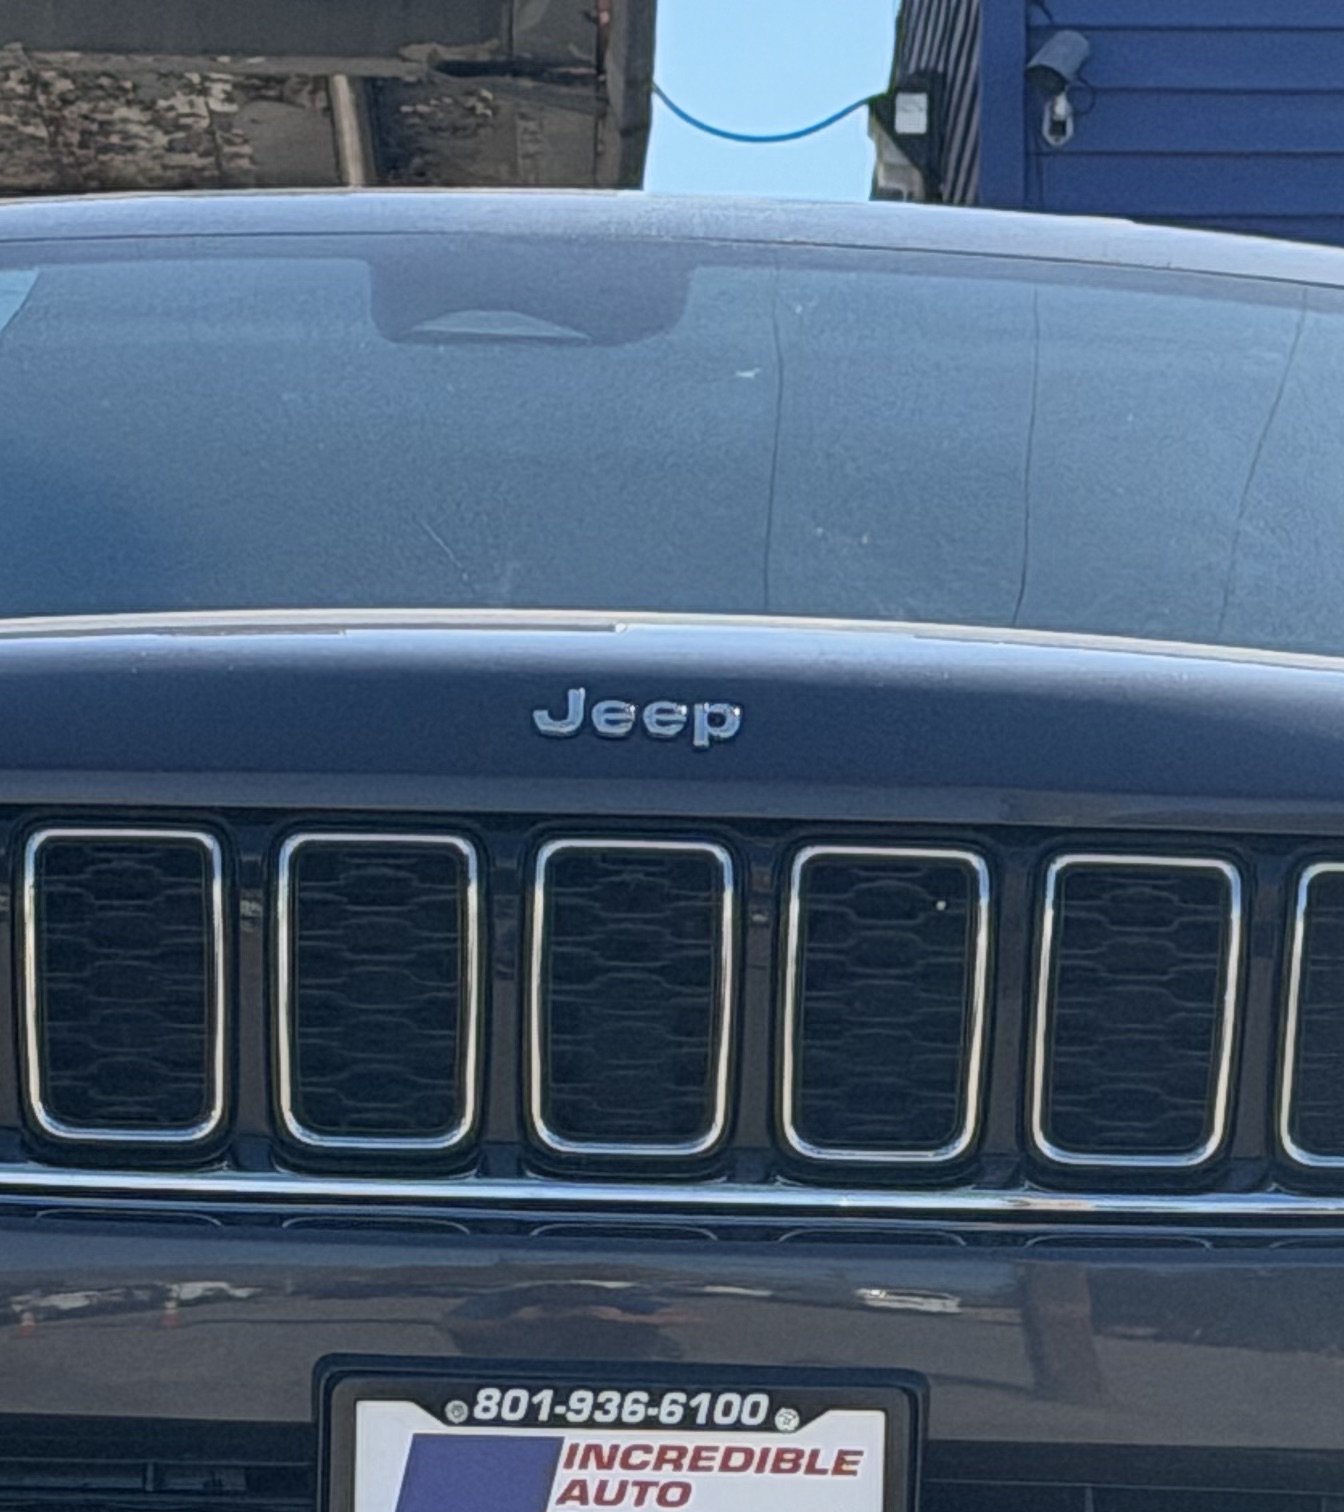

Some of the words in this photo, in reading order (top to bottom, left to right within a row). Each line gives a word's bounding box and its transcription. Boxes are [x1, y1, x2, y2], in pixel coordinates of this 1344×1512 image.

[532, 687, 741, 747] Jeep
[474, 1387, 769, 1425] 801-936-6100
[563, 1443, 864, 1477] INCREDIBLE
[557, 1480, 692, 1508] AUTO
